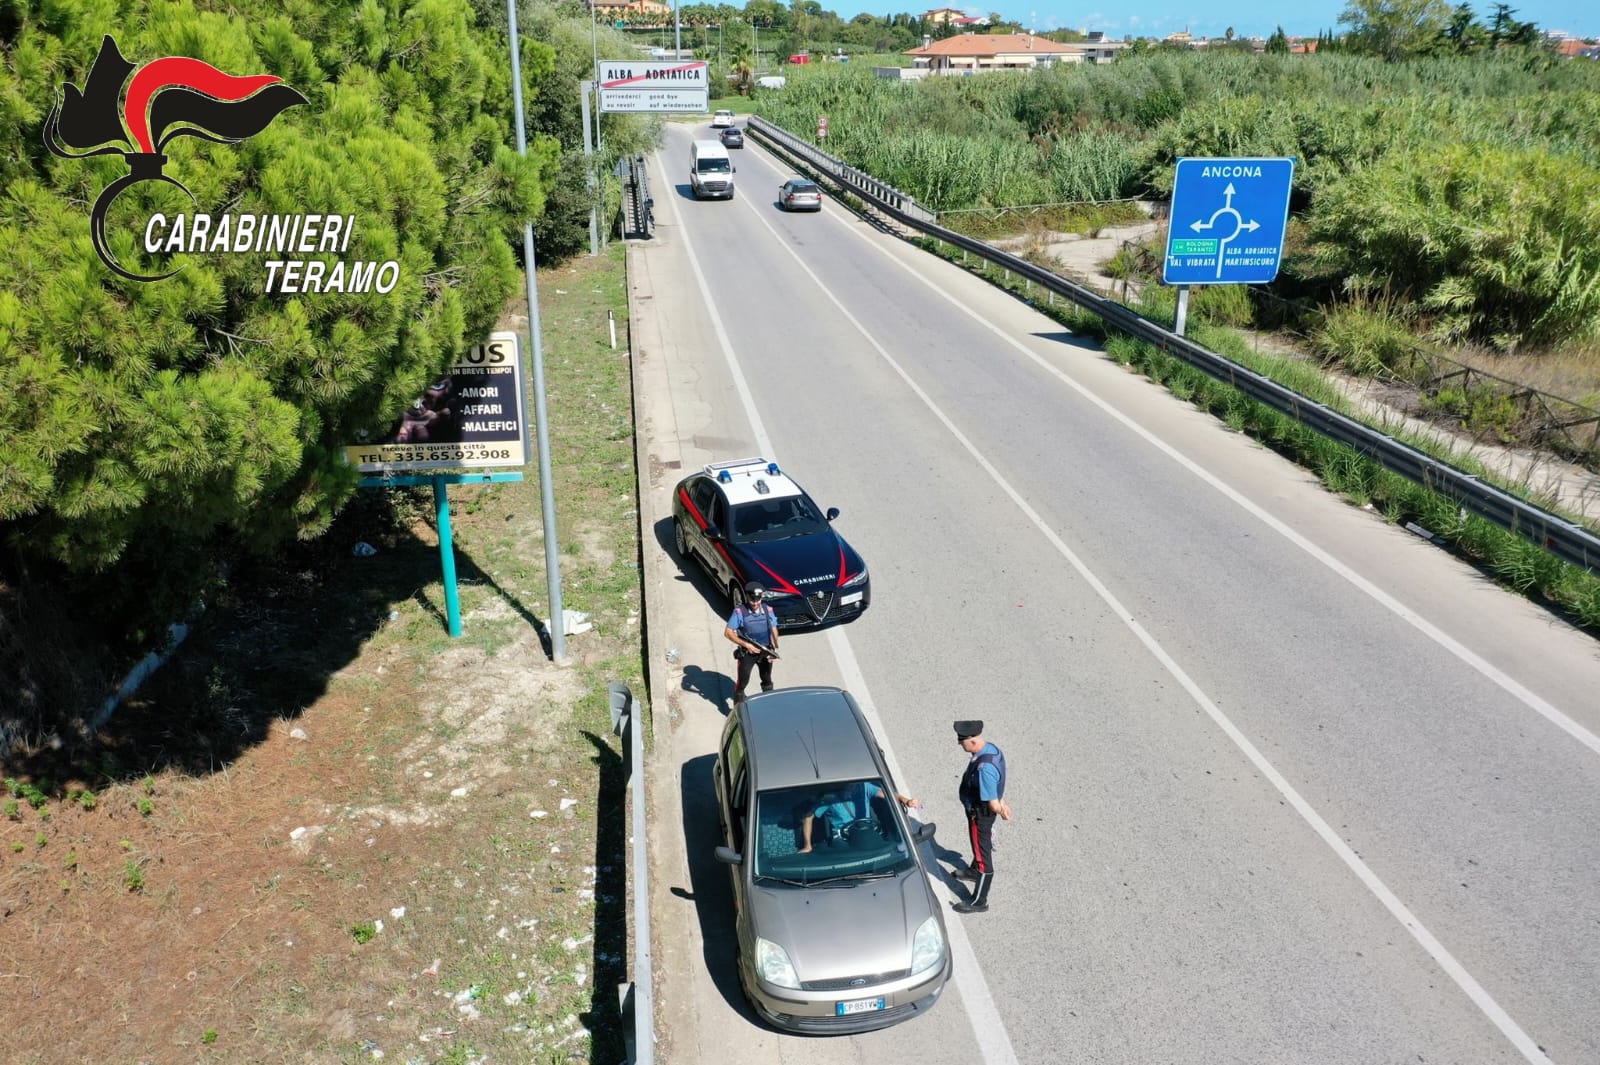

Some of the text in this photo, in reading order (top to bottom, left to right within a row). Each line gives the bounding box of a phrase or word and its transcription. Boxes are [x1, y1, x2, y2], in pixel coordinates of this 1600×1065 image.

[608, 69, 700, 80] ALBA ADRIATICA
[1201, 166, 1262, 178] ANCONA
[1226, 247, 1277, 255] ALBA ADRIATICA
[1170, 257, 1216, 267] VAL VIBRATA
[1224, 257, 1275, 266] MARTINSICURO
[458, 386, 499, 398] -AMORI
[460, 404, 502, 415] -AFFARI
[461, 421, 517, 432] -MALEFICI
[426, 444, 461, 452] questa
[360, 450, 510, 463] TEL. 335.65.92.908
[794, 573, 836, 586] CARABINIERI
